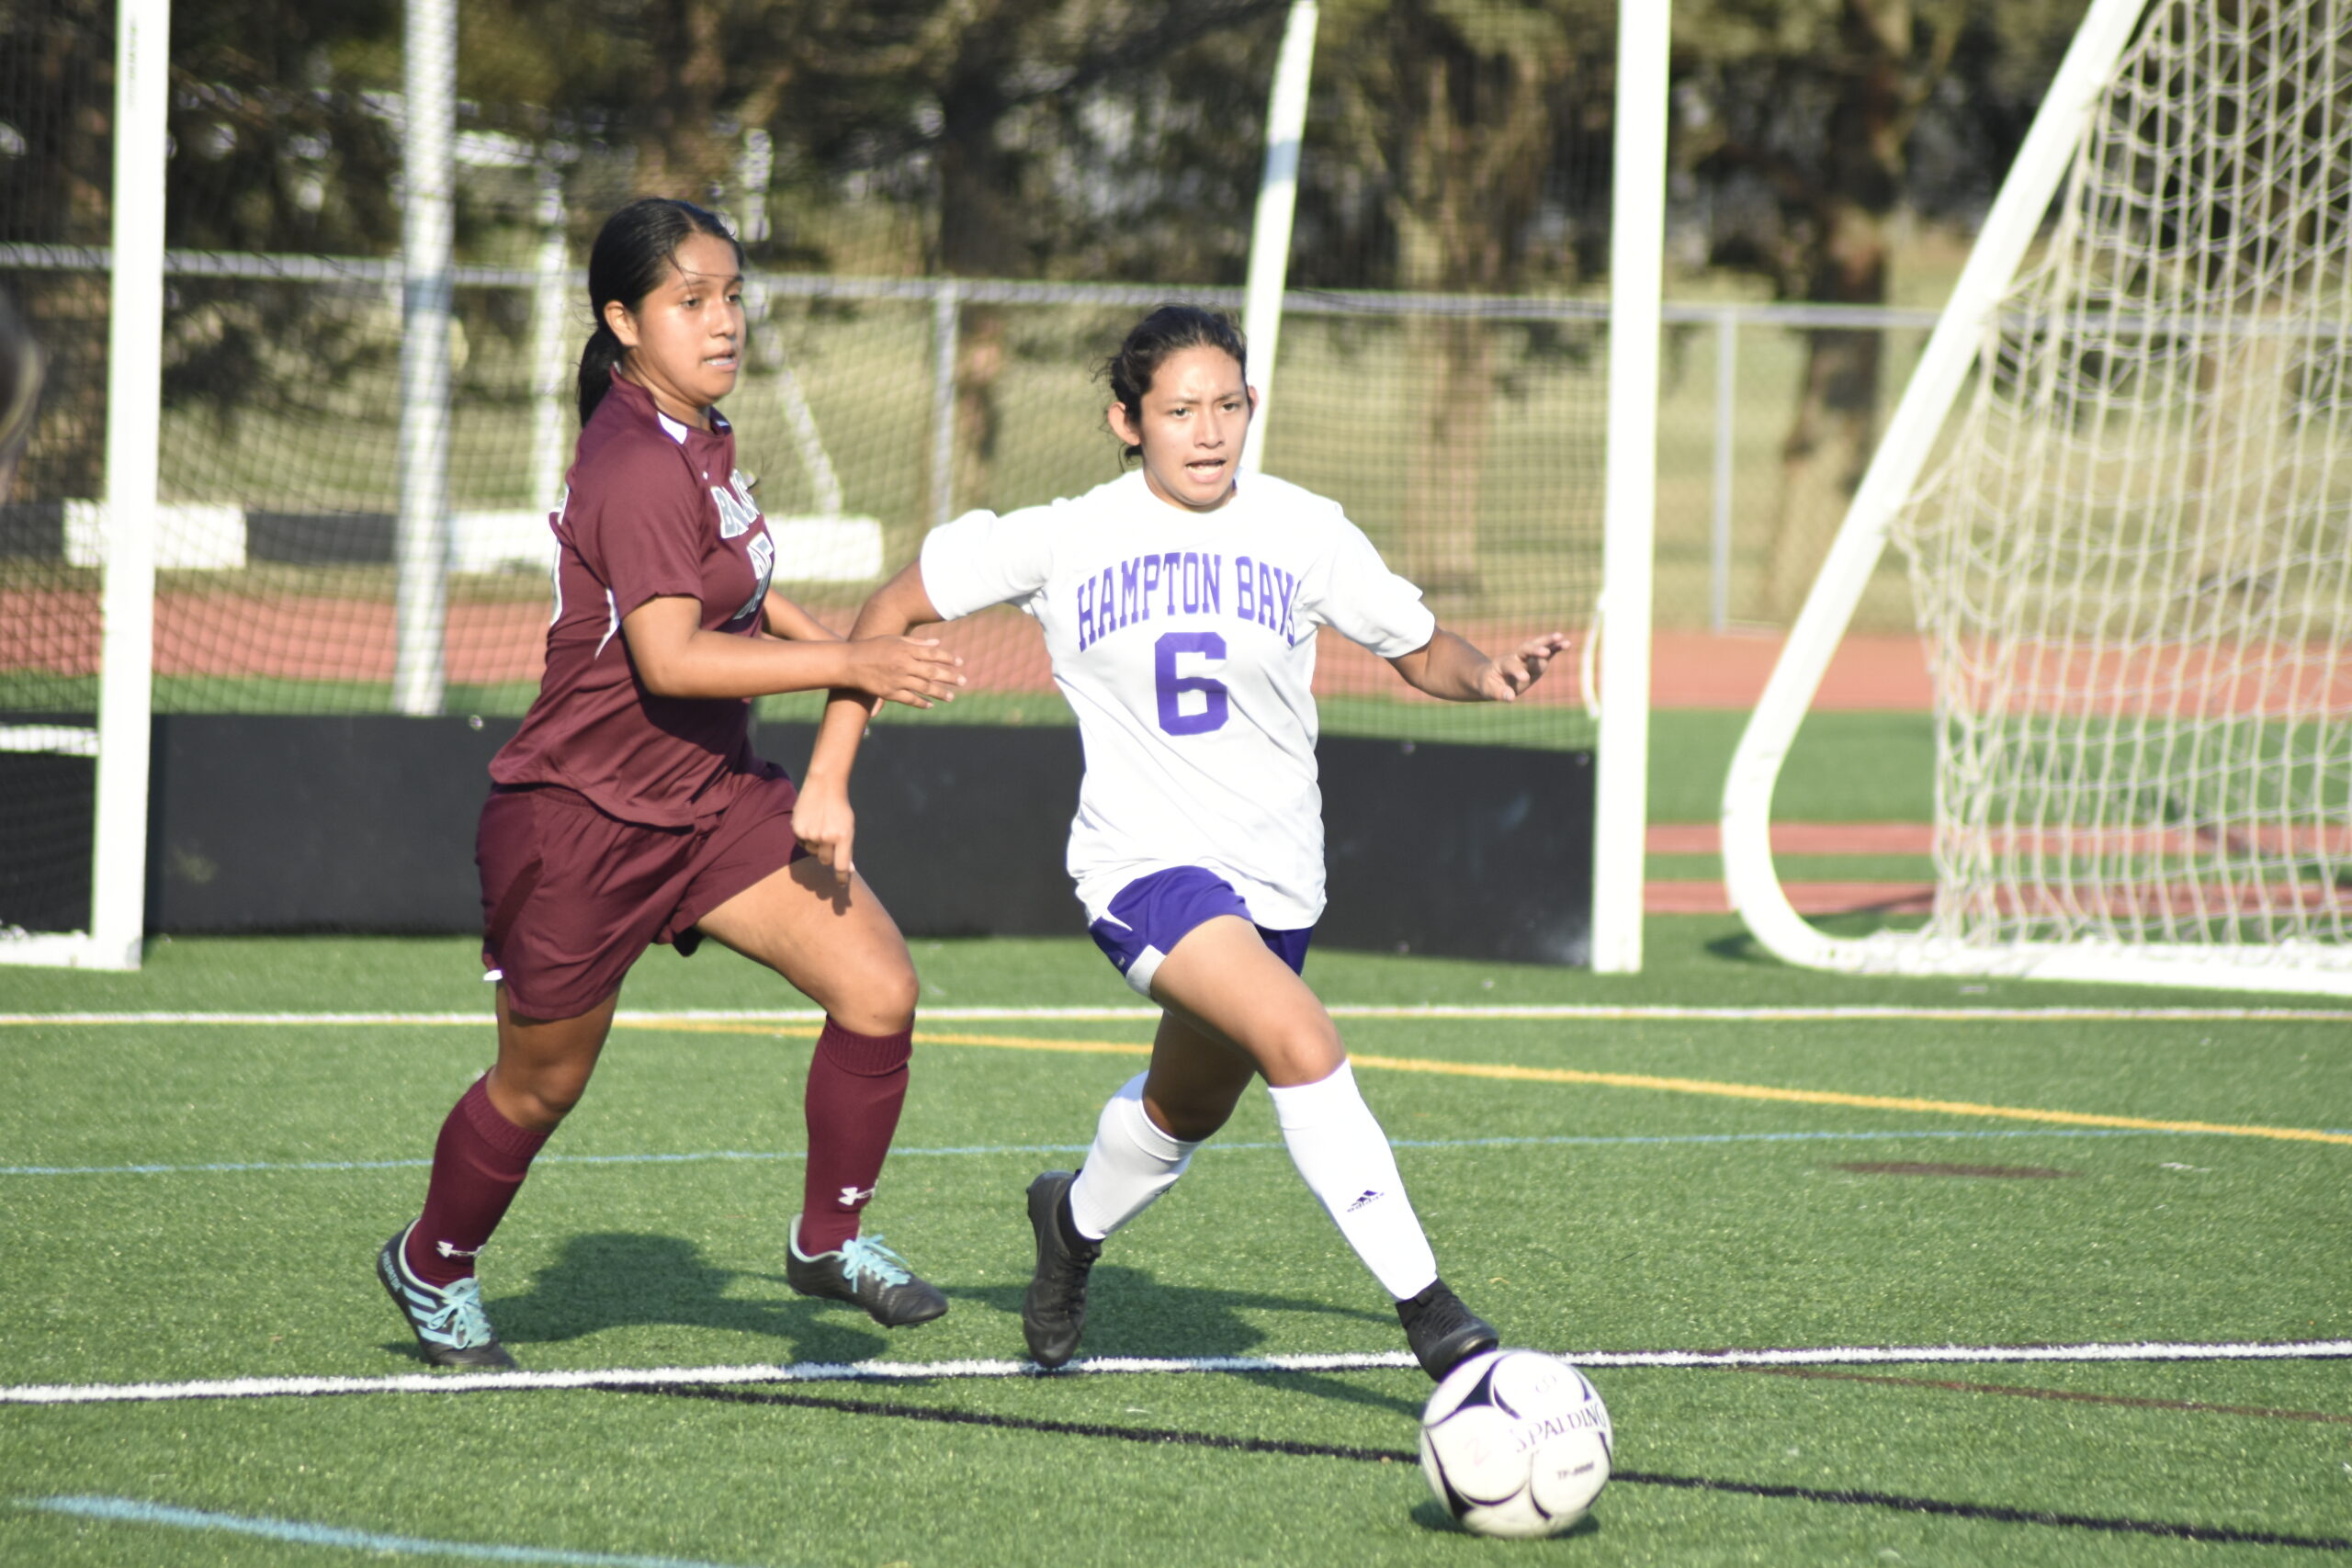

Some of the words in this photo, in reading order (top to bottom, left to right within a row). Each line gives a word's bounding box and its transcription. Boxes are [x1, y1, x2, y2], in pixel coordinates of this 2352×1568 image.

[1077, 551, 1222, 653] HAMPTON
[1154, 631, 1229, 737] 6
[1510, 1402, 1607, 1453] SPALDING
